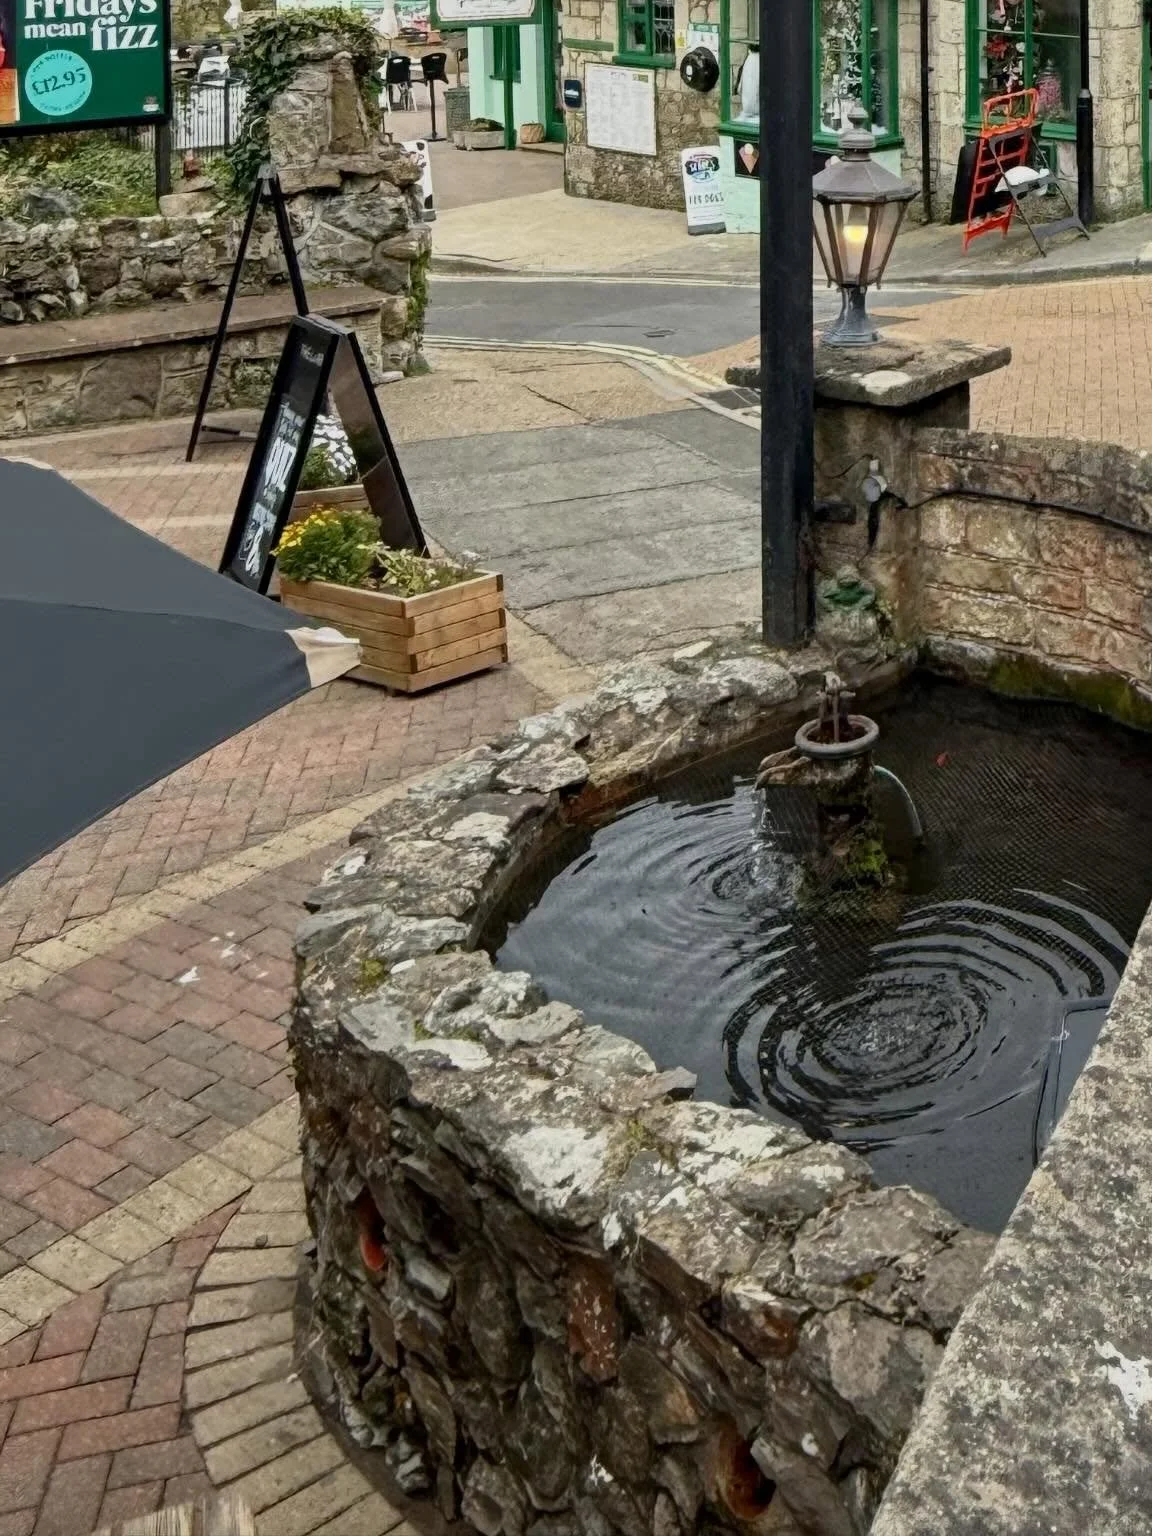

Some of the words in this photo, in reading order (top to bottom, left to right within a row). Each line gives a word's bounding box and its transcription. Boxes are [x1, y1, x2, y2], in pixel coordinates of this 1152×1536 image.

[24, 21, 87, 39] mean
[91, 15, 159, 52] fizz
[32, 67, 87, 95] £12.95
